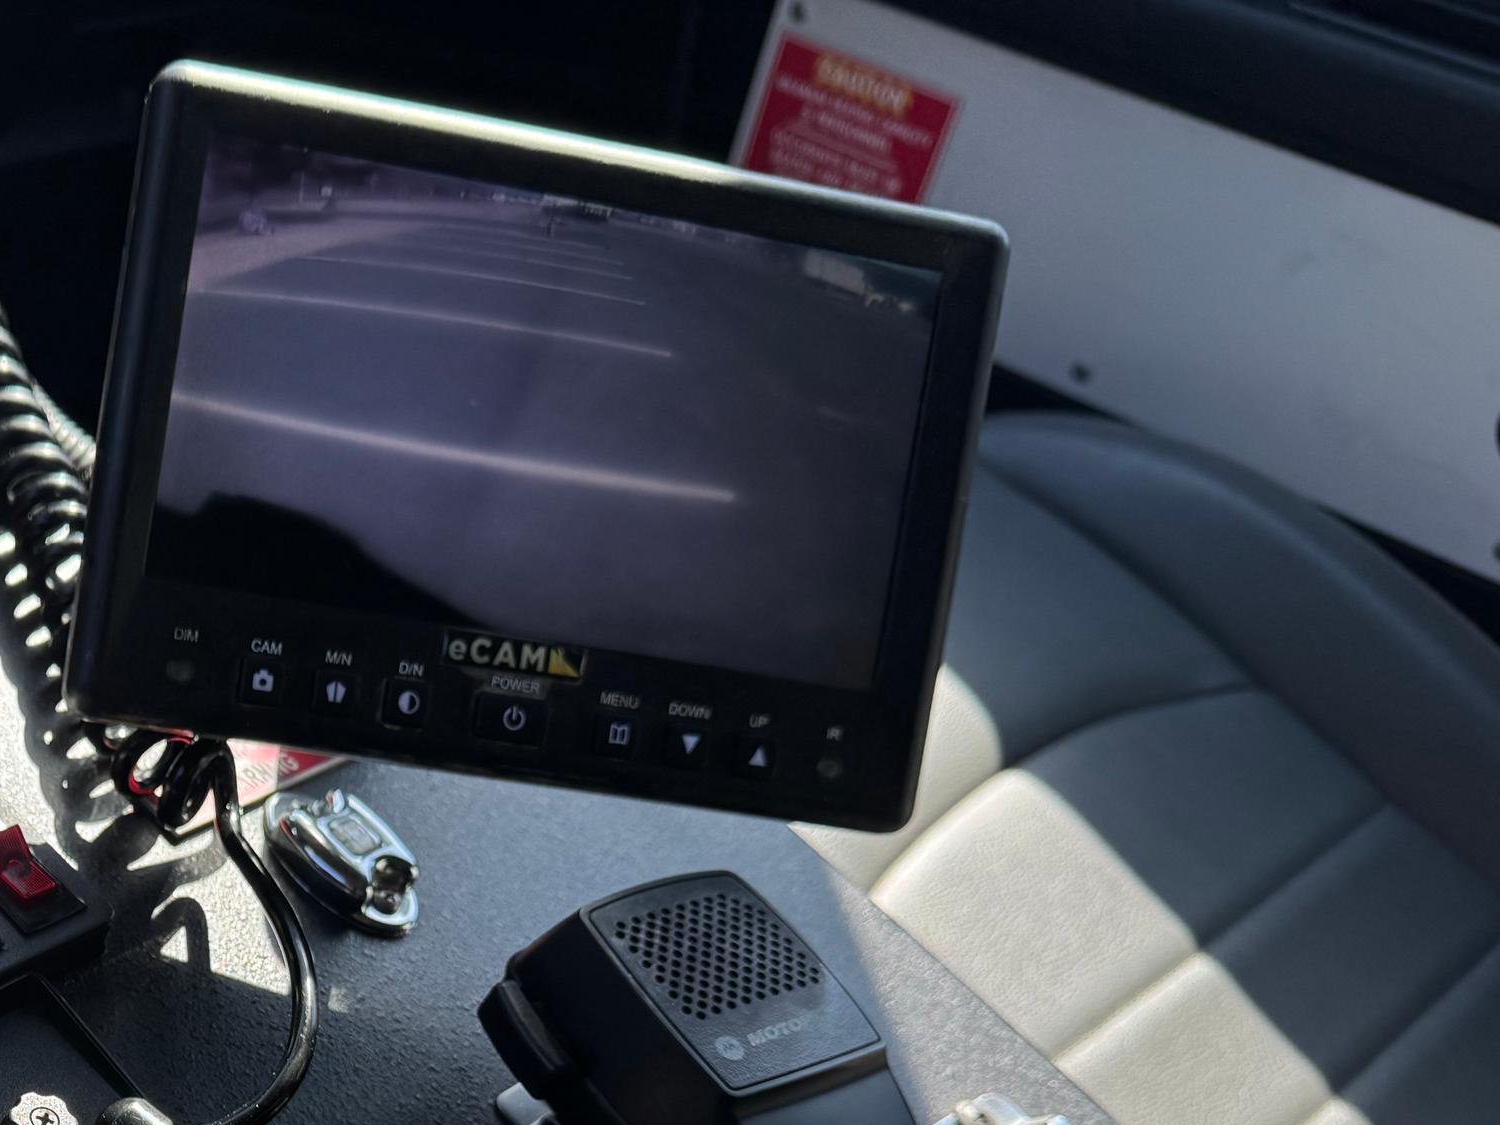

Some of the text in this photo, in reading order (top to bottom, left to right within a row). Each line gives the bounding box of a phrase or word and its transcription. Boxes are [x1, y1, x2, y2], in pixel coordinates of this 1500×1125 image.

[173, 626, 199, 643] DIM
[250, 637, 284, 656] CAM
[447, 635, 548, 673] eCAM
[325, 648, 352, 667] M/N
[398, 660, 424, 678] D/N
[490, 675, 542, 696] POWER
[600, 690, 642, 710] MENU
[667, 700, 713, 720] DOWN
[749, 712, 772, 728] UP
